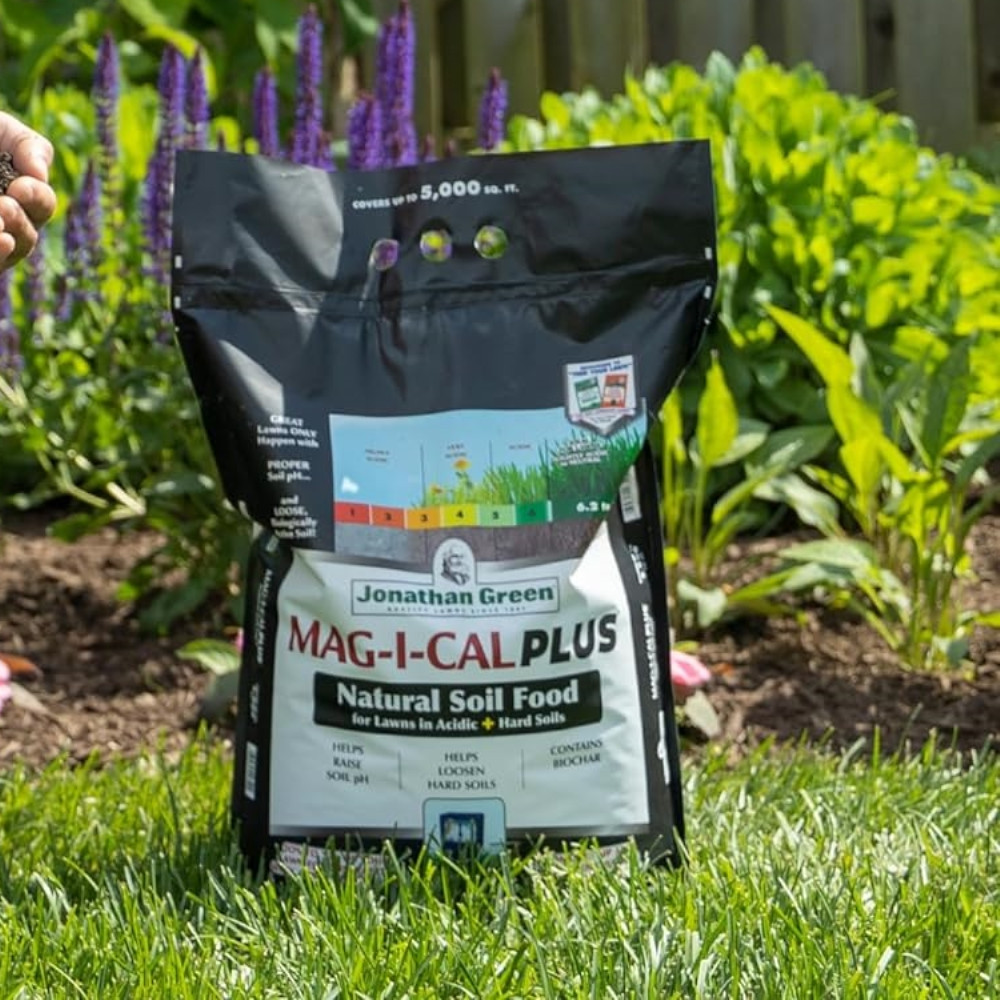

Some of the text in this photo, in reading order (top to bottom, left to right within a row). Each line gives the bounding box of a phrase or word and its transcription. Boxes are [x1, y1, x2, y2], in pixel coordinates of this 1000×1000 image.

[352, 198, 391, 209] COVERS
[420, 180, 481, 201] 5,000
[290, 427, 317, 438] ONLY
[257, 436, 295, 448] Happen
[267, 460, 310, 470] PROPER
[267, 471, 285, 481] Soil
[357, 586, 554, 606] Jonathan Green
[288, 613, 618, 670] MAG-I-CAL PLUS
[336, 679, 579, 713] Natural Soil Food
[352, 712, 371, 726] for
[374, 715, 416, 730] Lawns
[419, 716, 433, 731] in
[435, 717, 478, 731] Acidic
[499, 714, 532, 729] Hard
[535, 711, 566, 726] Soils
[332, 742, 364, 755] HELPS
[550, 738, 603, 756] CONTAINS
[333, 756, 362, 769] RAISE
[444, 752, 478, 762] HELPS
[553, 753, 601, 769] BIOCHAR
[438, 765, 485, 776] LOOSEN
[326, 770, 369, 785] SOIL pH
[427, 779, 496, 790] HARD SOILS
